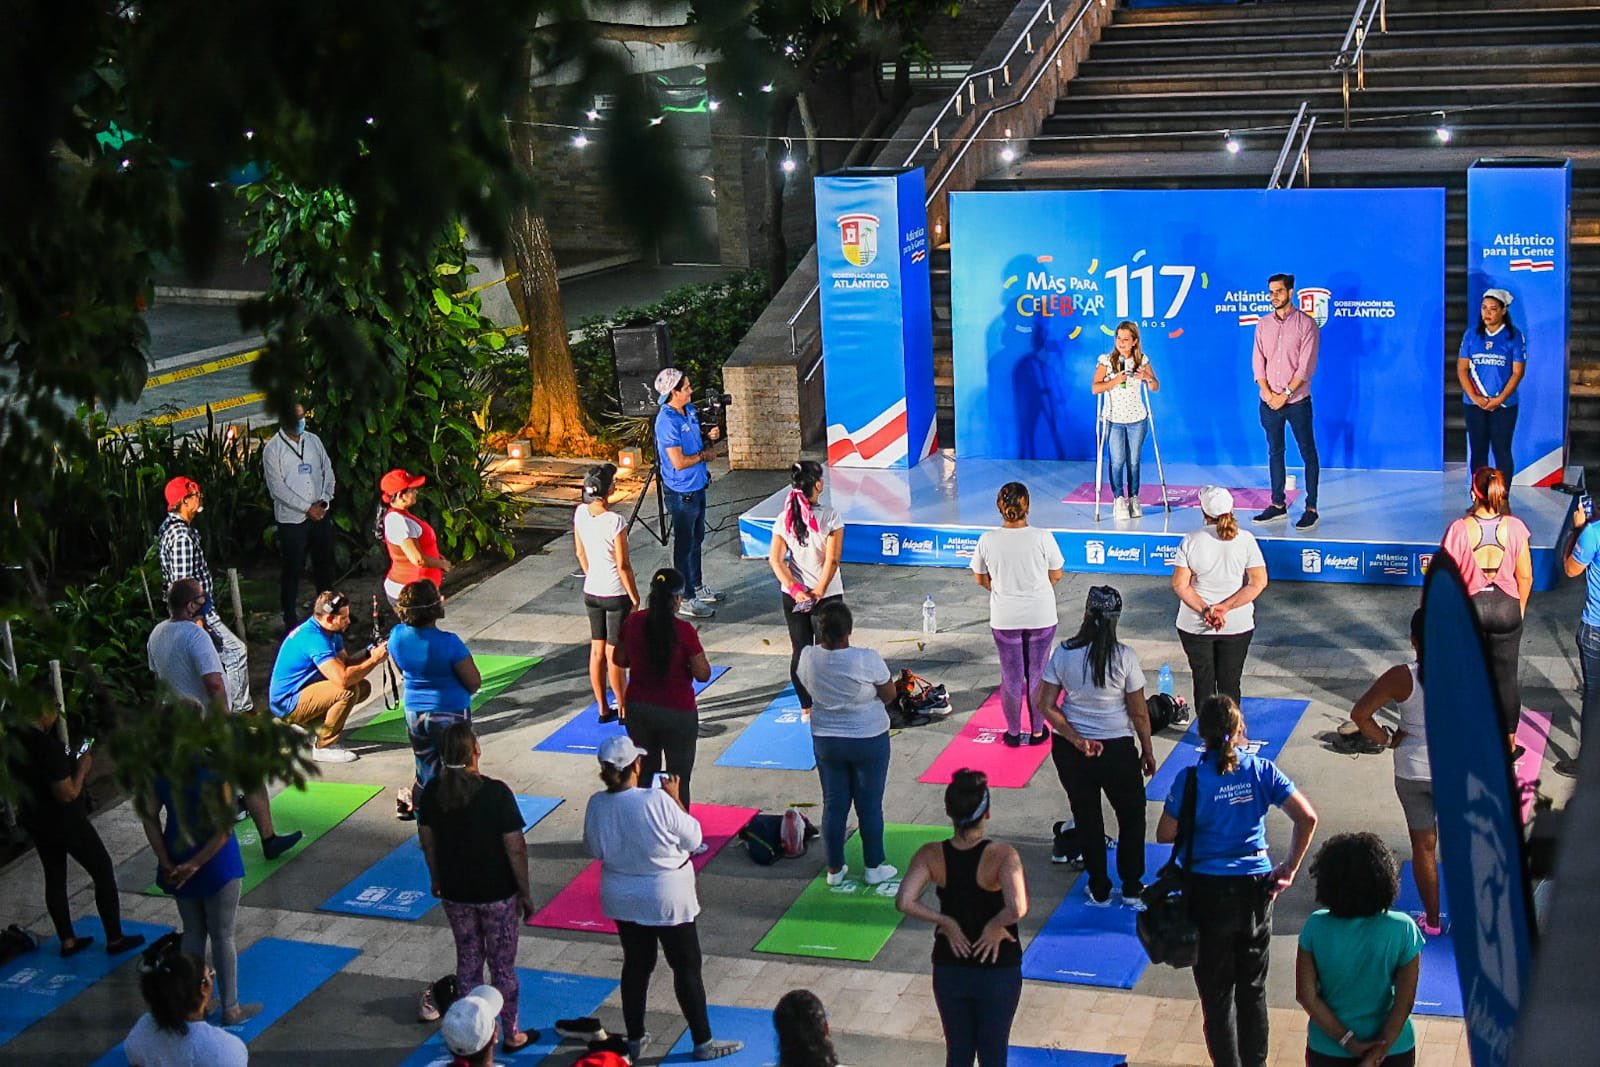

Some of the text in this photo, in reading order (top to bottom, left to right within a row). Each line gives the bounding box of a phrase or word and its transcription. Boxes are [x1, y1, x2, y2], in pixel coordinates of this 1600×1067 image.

[1493, 233, 1555, 246] Atlántico
[1483, 246, 1555, 259] para la Gente
[833, 279, 889, 289] ATLÁNTICO
[1070, 277, 1098, 291] PARA
[1104, 264, 1196, 319] 117
[1224, 290, 1271, 302] Atlántic
[1016, 293, 1104, 317] CELEBRAR
[1215, 302, 1275, 314] para la Gent
[1334, 307, 1396, 318] ATLÁNTICO
[1376, 553, 1408, 561] Atlántico
